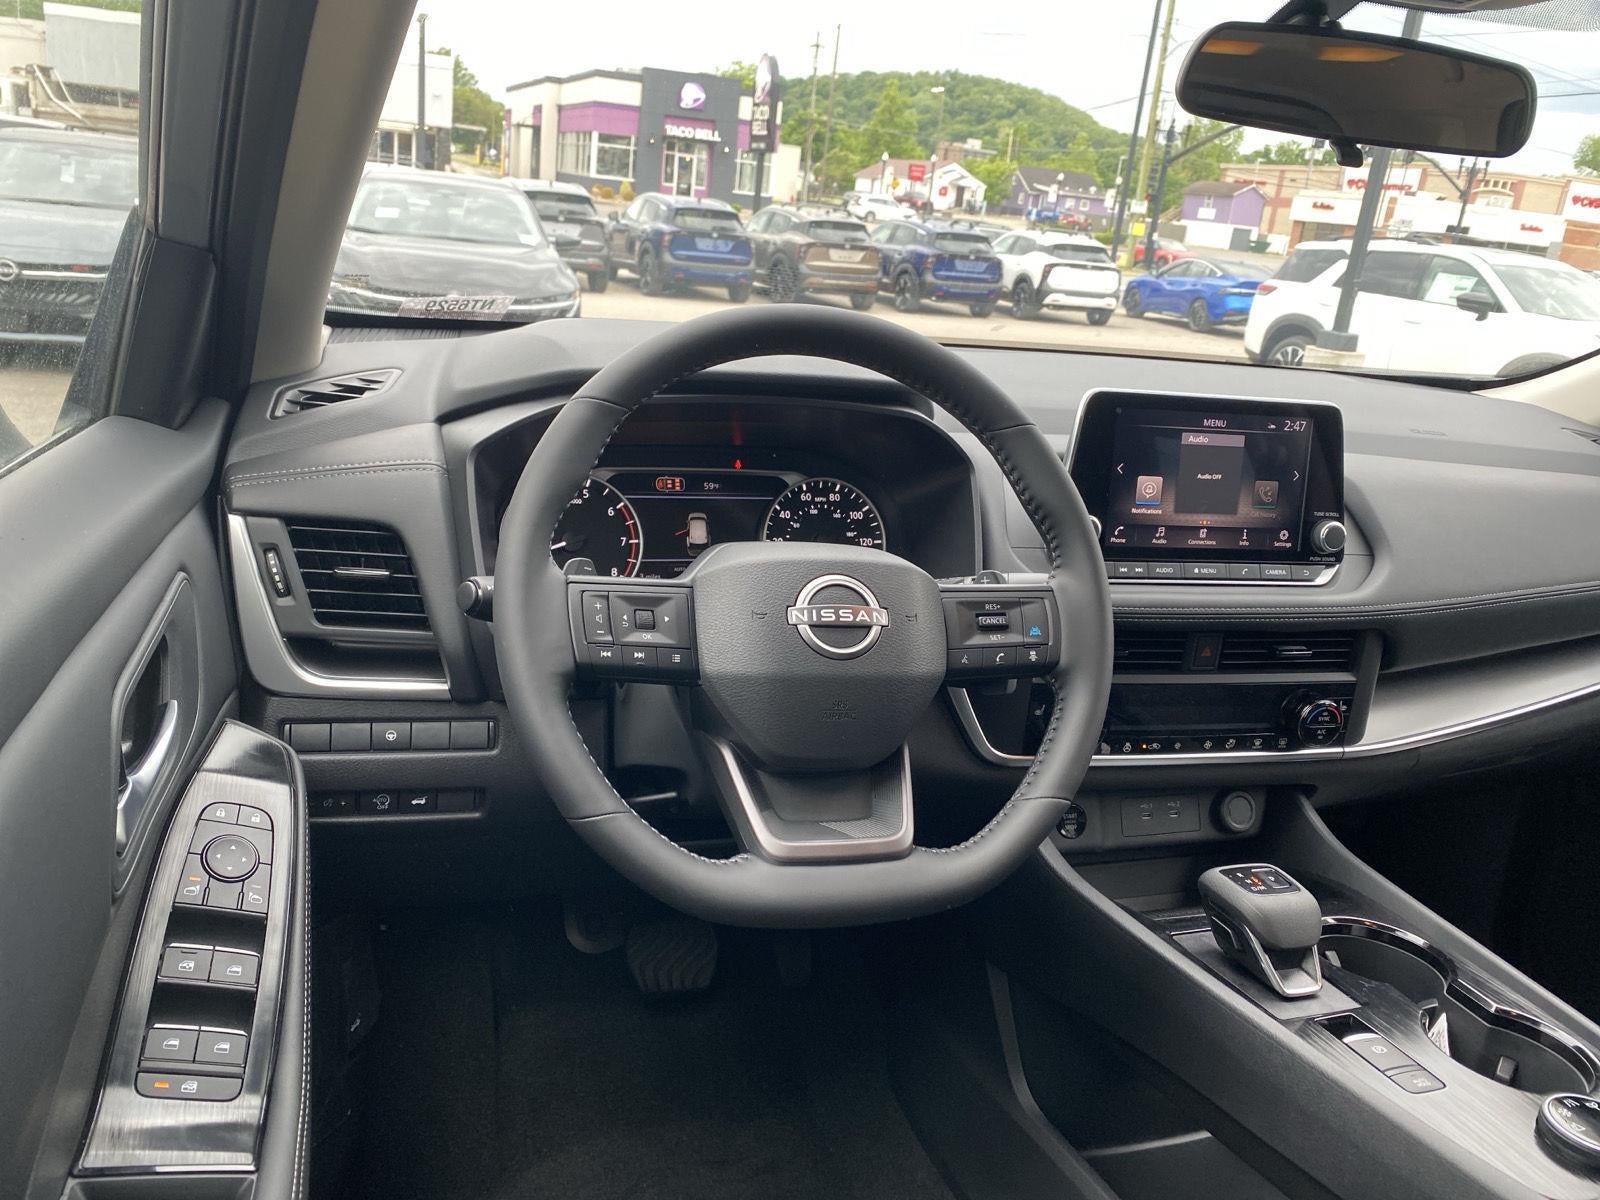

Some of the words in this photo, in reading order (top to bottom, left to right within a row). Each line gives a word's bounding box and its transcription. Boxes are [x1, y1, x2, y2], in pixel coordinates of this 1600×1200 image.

[753, 105, 770, 120] TACO
[752, 120, 768, 135] BELL
[665, 124, 694, 138] TACO
[694, 128, 721, 142] BELL
[1203, 419, 1227, 428] MENU
[1284, 420, 1307, 432] 2:47
[1188, 435, 1209, 443] Audio
[582, 489, 589, 499] 5
[800, 493, 812, 501] 60
[829, 493, 841, 502] 80
[607, 508, 615, 517] 6
[779, 510, 791, 519] 40
[849, 511, 863, 520] 100
[1131, 507, 1162, 515] Notifications
[620, 537, 627, 546] 7
[859, 538, 873, 547] 120
[1274, 541, 1292, 549] Settings
[611, 567, 618, 577] 8
[791, 608, 886, 624] NISSAN
